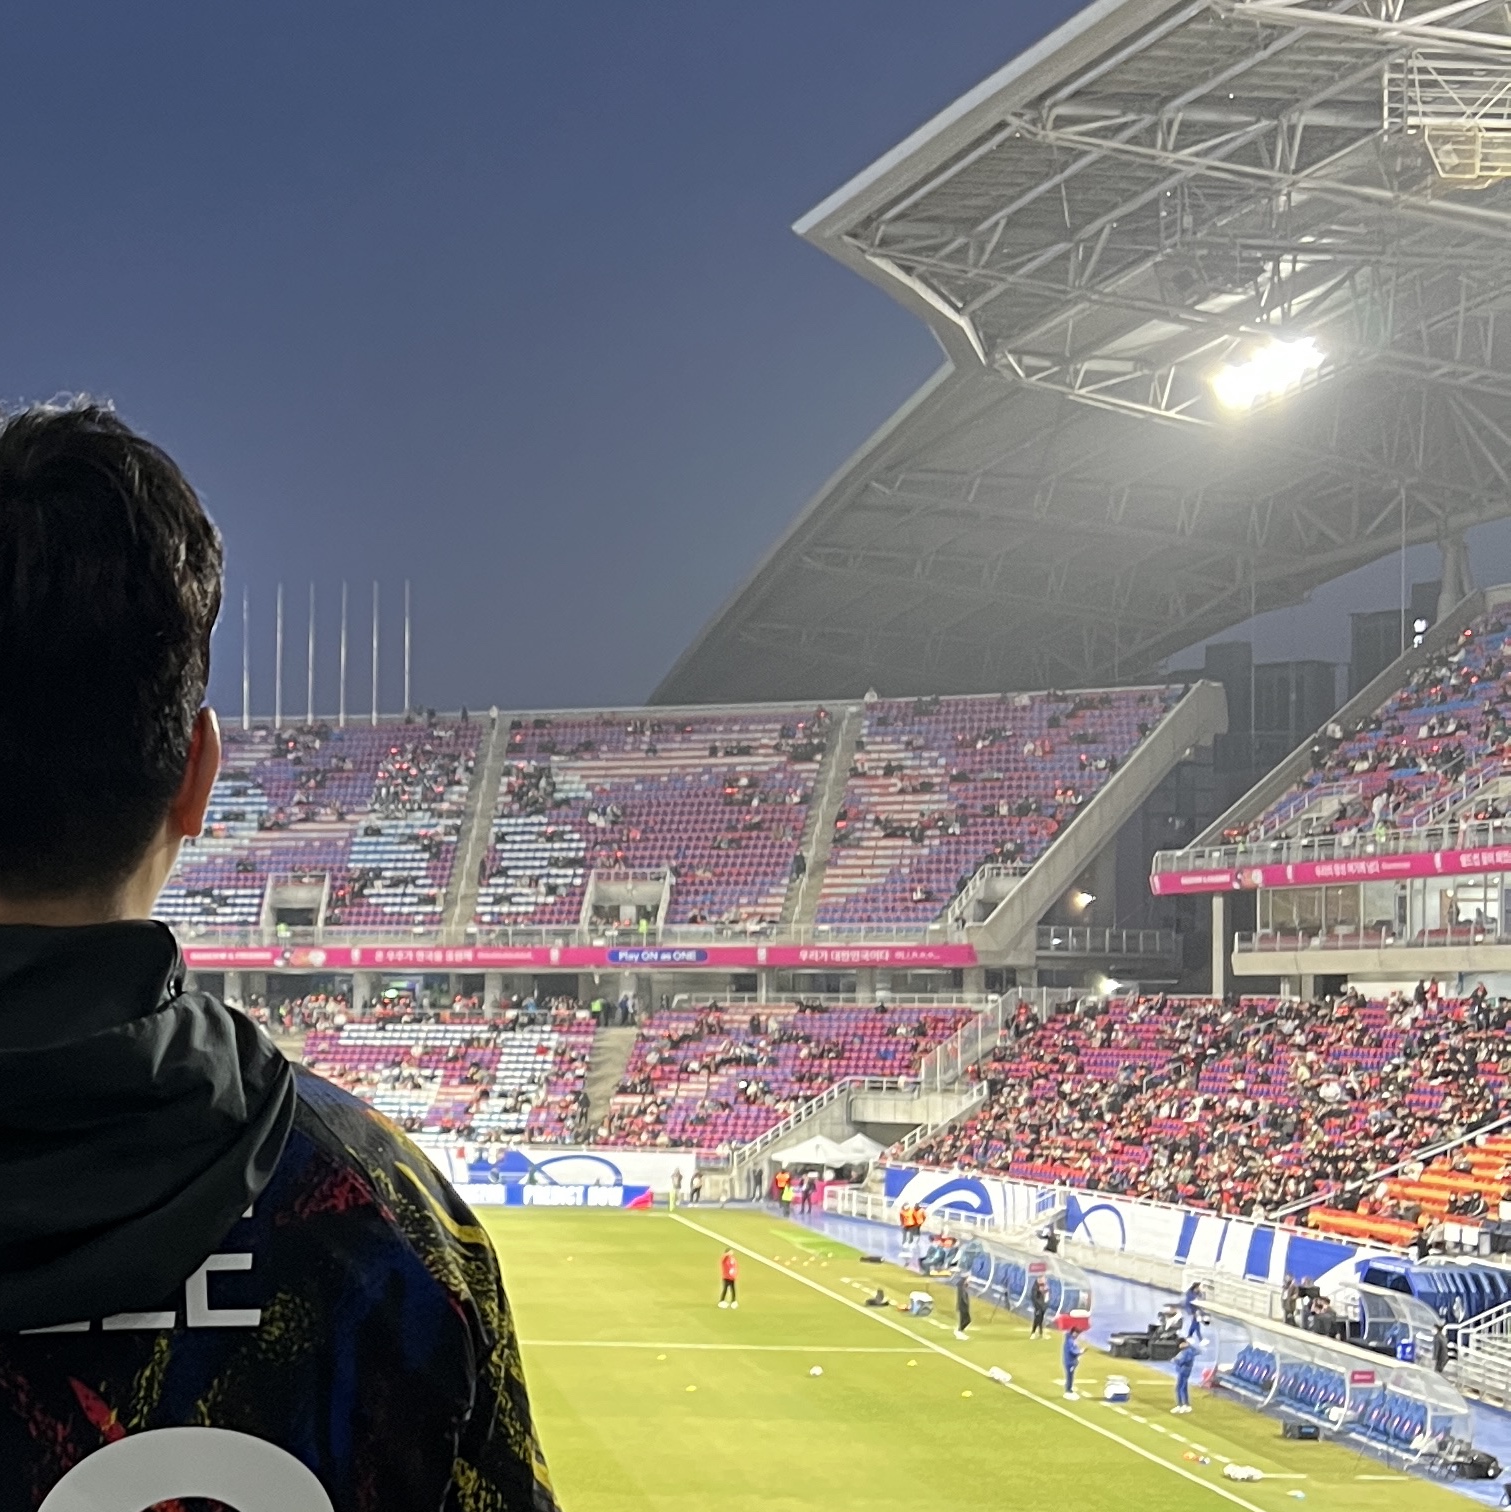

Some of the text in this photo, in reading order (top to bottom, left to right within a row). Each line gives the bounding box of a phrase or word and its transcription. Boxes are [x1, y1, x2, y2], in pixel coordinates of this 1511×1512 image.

[618, 950, 697, 963] Play ON as ONE
